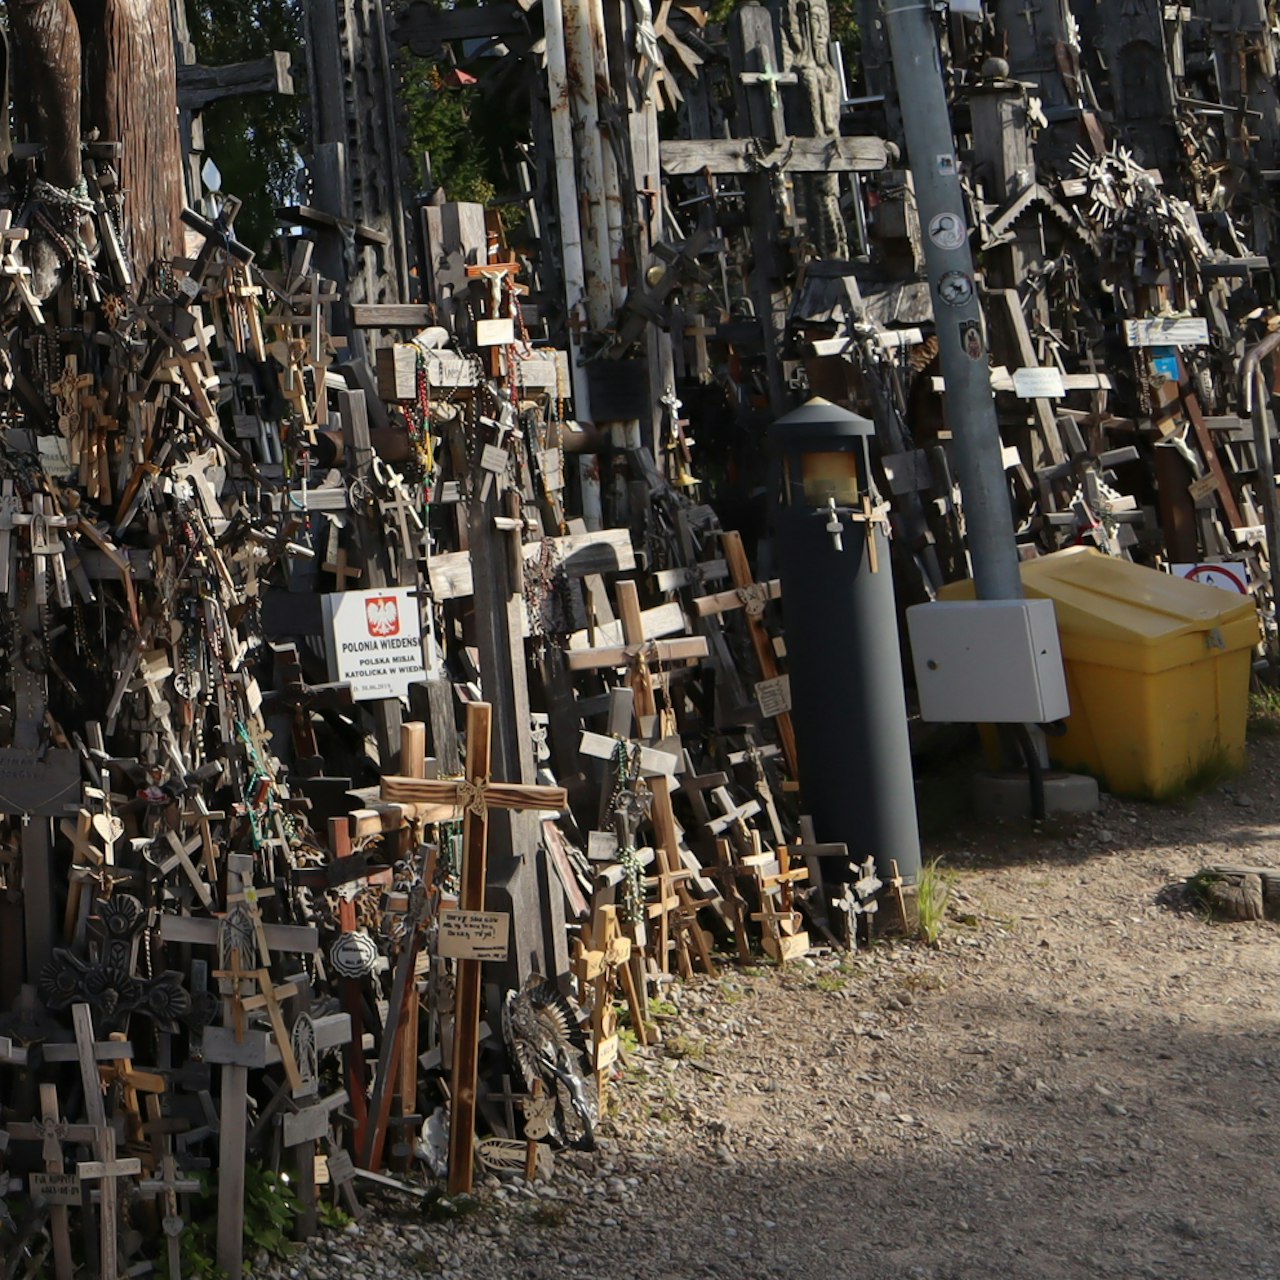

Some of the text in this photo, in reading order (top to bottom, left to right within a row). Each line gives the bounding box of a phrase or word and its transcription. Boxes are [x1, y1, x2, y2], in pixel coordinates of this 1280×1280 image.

[342, 634, 421, 653] POLONIA WIEDEŃS
[360, 655, 415, 666] POLSKA MISJA
[345, 668, 387, 678] KATOLICKA
[398, 665, 425, 673] WIEDN
